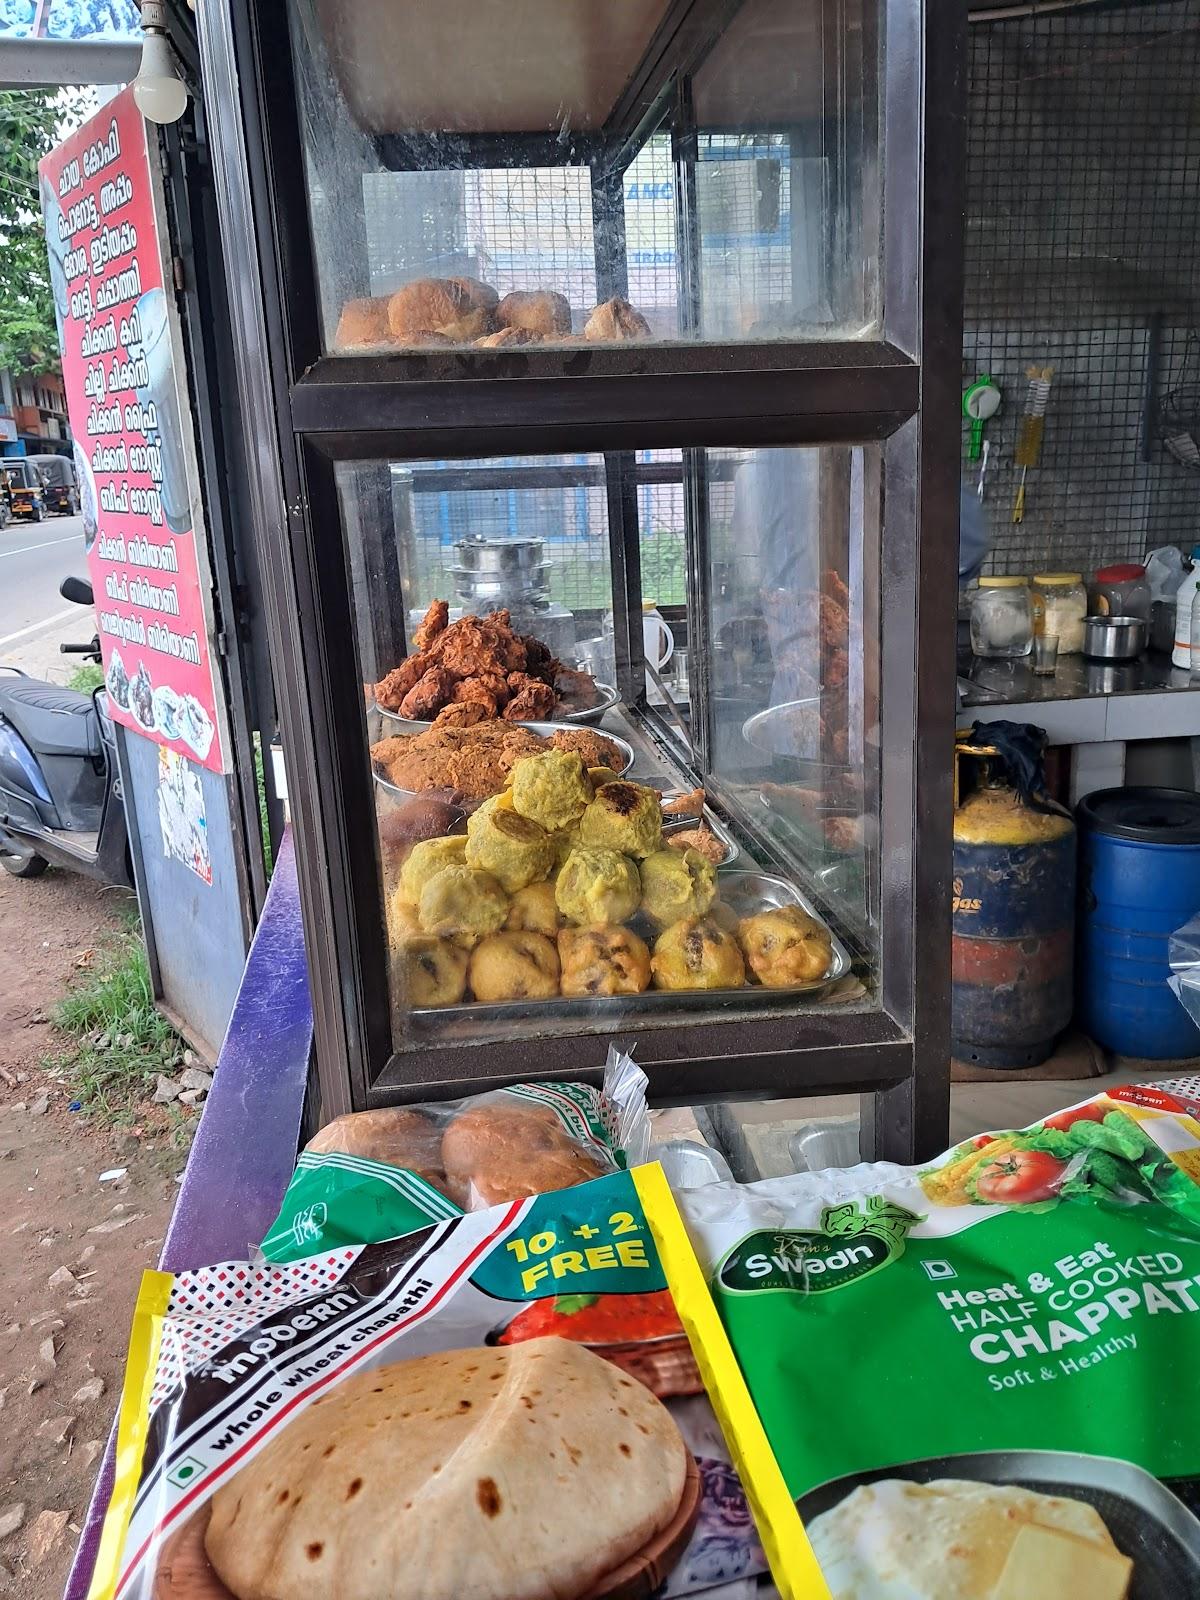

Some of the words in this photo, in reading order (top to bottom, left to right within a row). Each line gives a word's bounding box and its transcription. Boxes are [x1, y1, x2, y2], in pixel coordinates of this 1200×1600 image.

[83, 118, 120, 176] കോഫി
[100, 173, 133, 215] അപ്പം
[90, 221, 137, 275] ഇടിയപ്പം
[97, 257, 142, 311] ചപ്പാത്തി
[81, 313, 117, 357] ചിക്കൻ
[119, 305, 143, 346] കറി
[85, 360, 107, 403] ചില്ലി
[108, 350, 149, 393] ചിക്കൻ
[88, 399, 123, 435] ചിക്കൻ
[124, 401, 158, 438] ഫ്രൈ
[93, 438, 128, 473] ചിക്കൻ
[101, 481, 129, 514] ബീഫ്
[128, 535, 179, 572] ബിരിയാണി
[130, 575, 180, 616] ബിരിയാണി
[147, 620, 201, 665] ബിരിയാണി
[506, 1231, 557, 1262] 10
[572, 1224, 600, 1239] +
[608, 1212, 639, 1236] 2
[521, 1240, 650, 1294] FREE
[936, 1282, 1023, 1310] Heat
[1027, 1272, 1054, 1293] &
[1054, 1241, 1116, 1279] Eat
[950, 1301, 1038, 1333] HALF
[1048, 1252, 1183, 1311] COOKED
[210, 1391, 283, 1451] whole
[282, 1343, 352, 1387] wheat
[350, 1278, 434, 1342] chapathi
[988, 1369, 1035, 1392] Soft
[1040, 1367, 1057, 1381] &
[1059, 1333, 1137, 1375] Healthy
